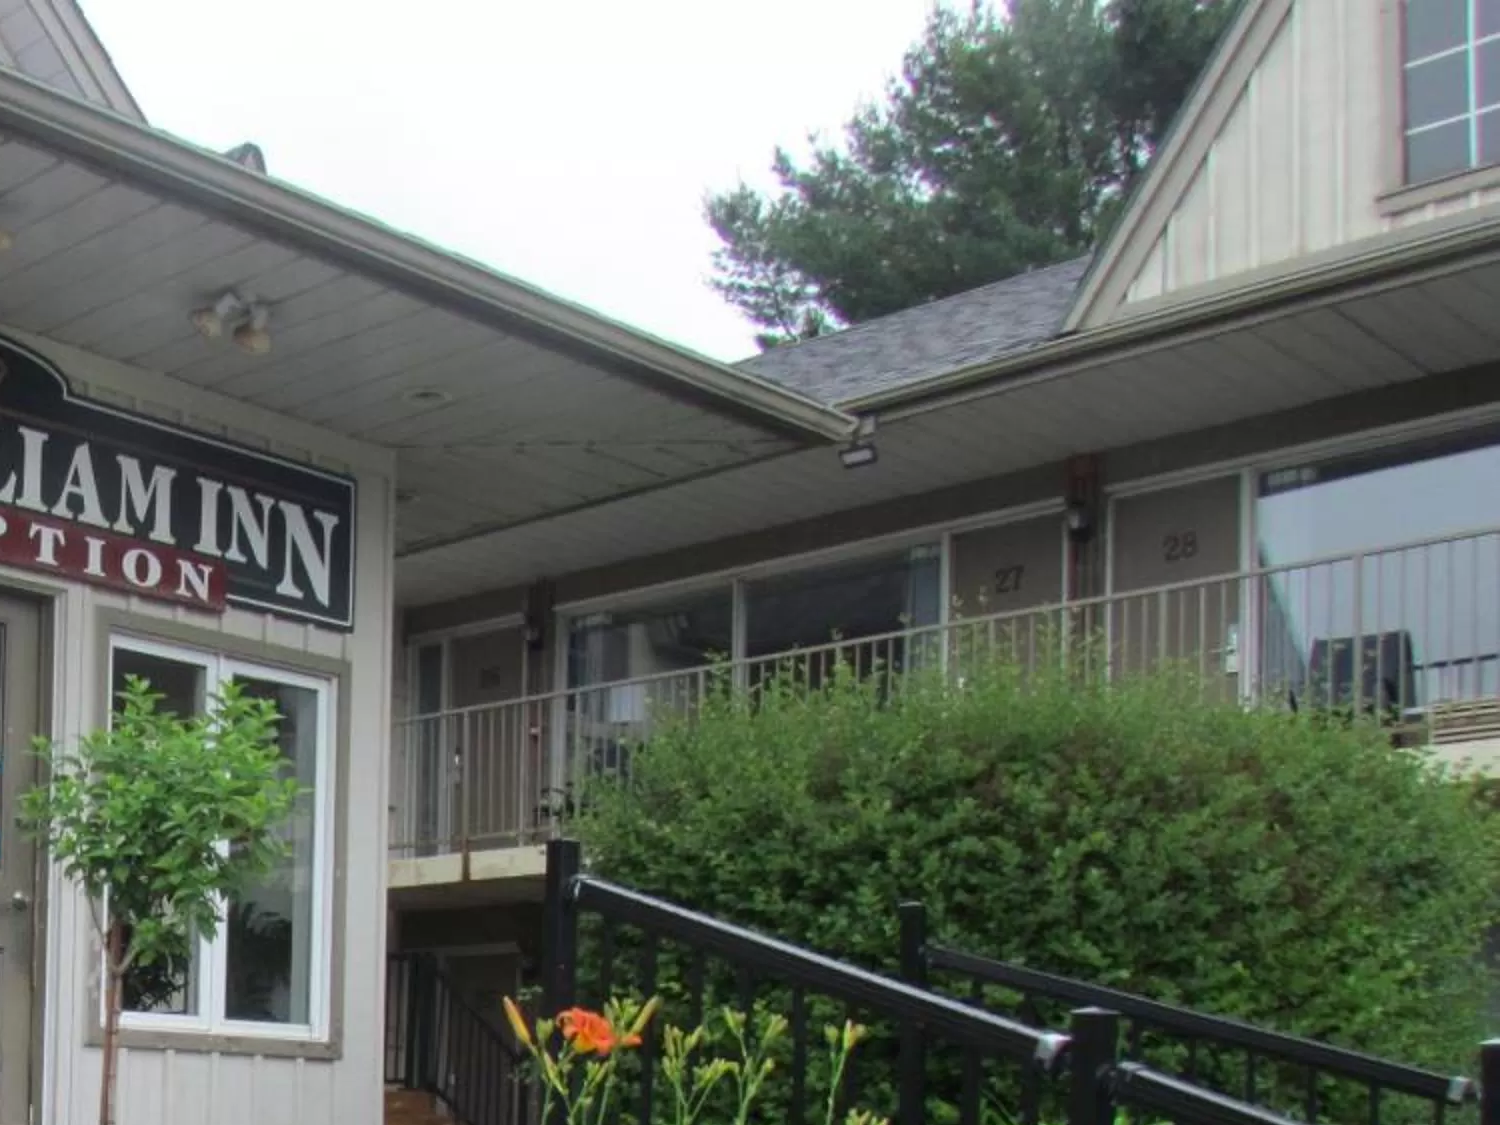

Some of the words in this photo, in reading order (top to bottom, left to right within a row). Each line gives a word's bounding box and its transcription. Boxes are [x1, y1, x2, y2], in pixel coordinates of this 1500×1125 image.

[194, 476, 339, 608] INN
[1161, 530, 1199, 563] 28
[995, 565, 1025, 594] 27
